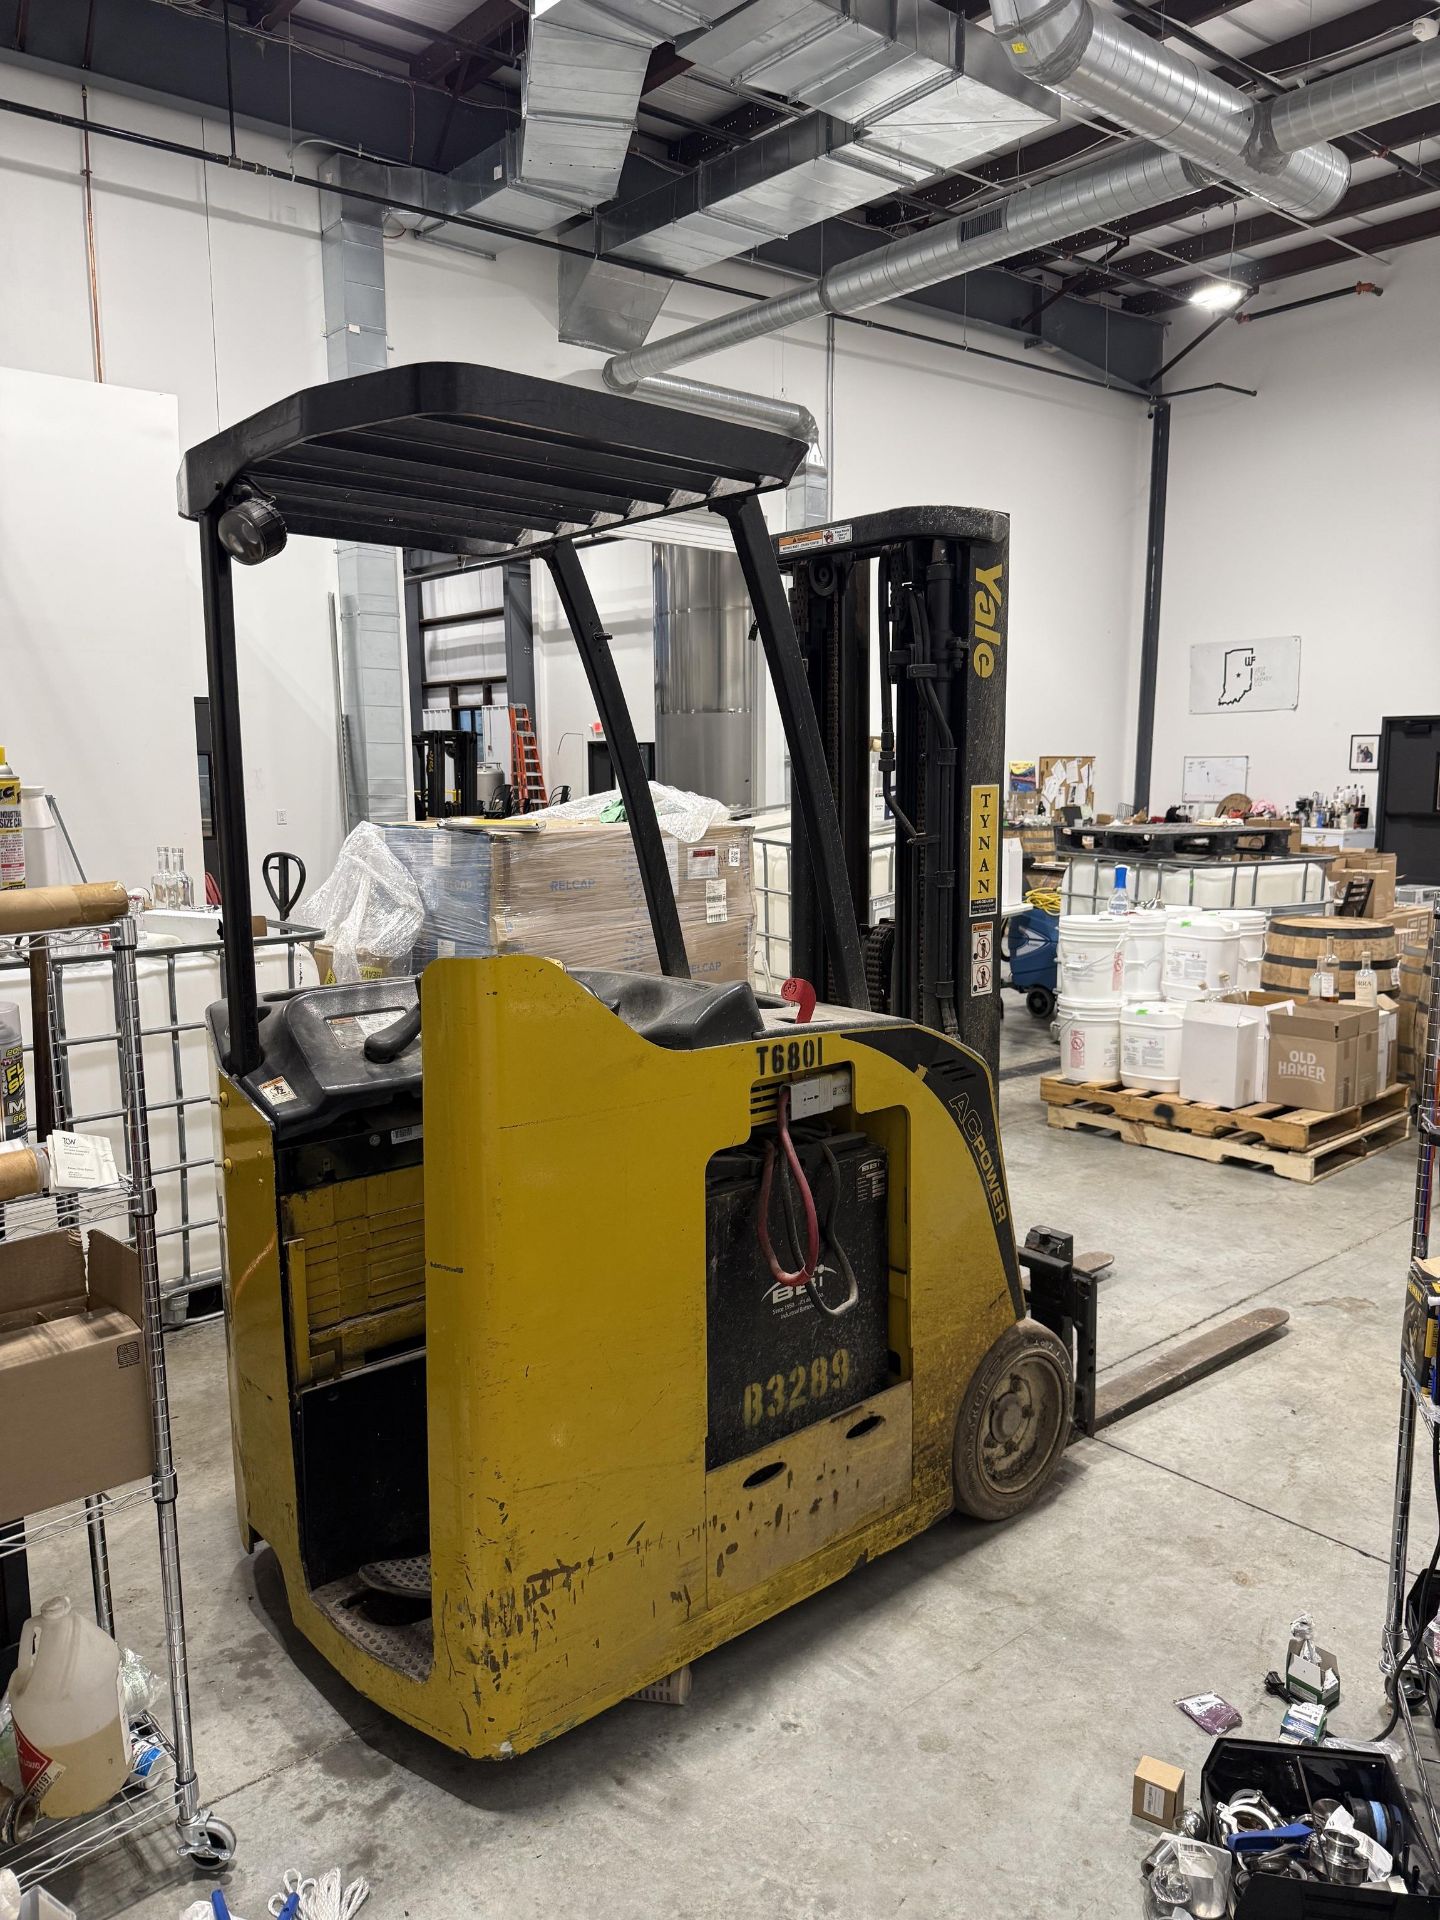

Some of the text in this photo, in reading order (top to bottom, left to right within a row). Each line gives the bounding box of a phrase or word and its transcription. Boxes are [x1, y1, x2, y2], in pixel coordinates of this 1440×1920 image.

[974, 563, 1003, 679] Yale
[978, 793, 992, 894] TYNAN
[549, 879, 596, 891] RELCAP
[690, 962, 722, 974] ELCAP
[756, 1036, 823, 1076] T6801
[1278, 1061, 1326, 1081] HAMER
[1289, 1050, 1316, 1064] OLD
[743, 1348, 850, 1431] B3289
